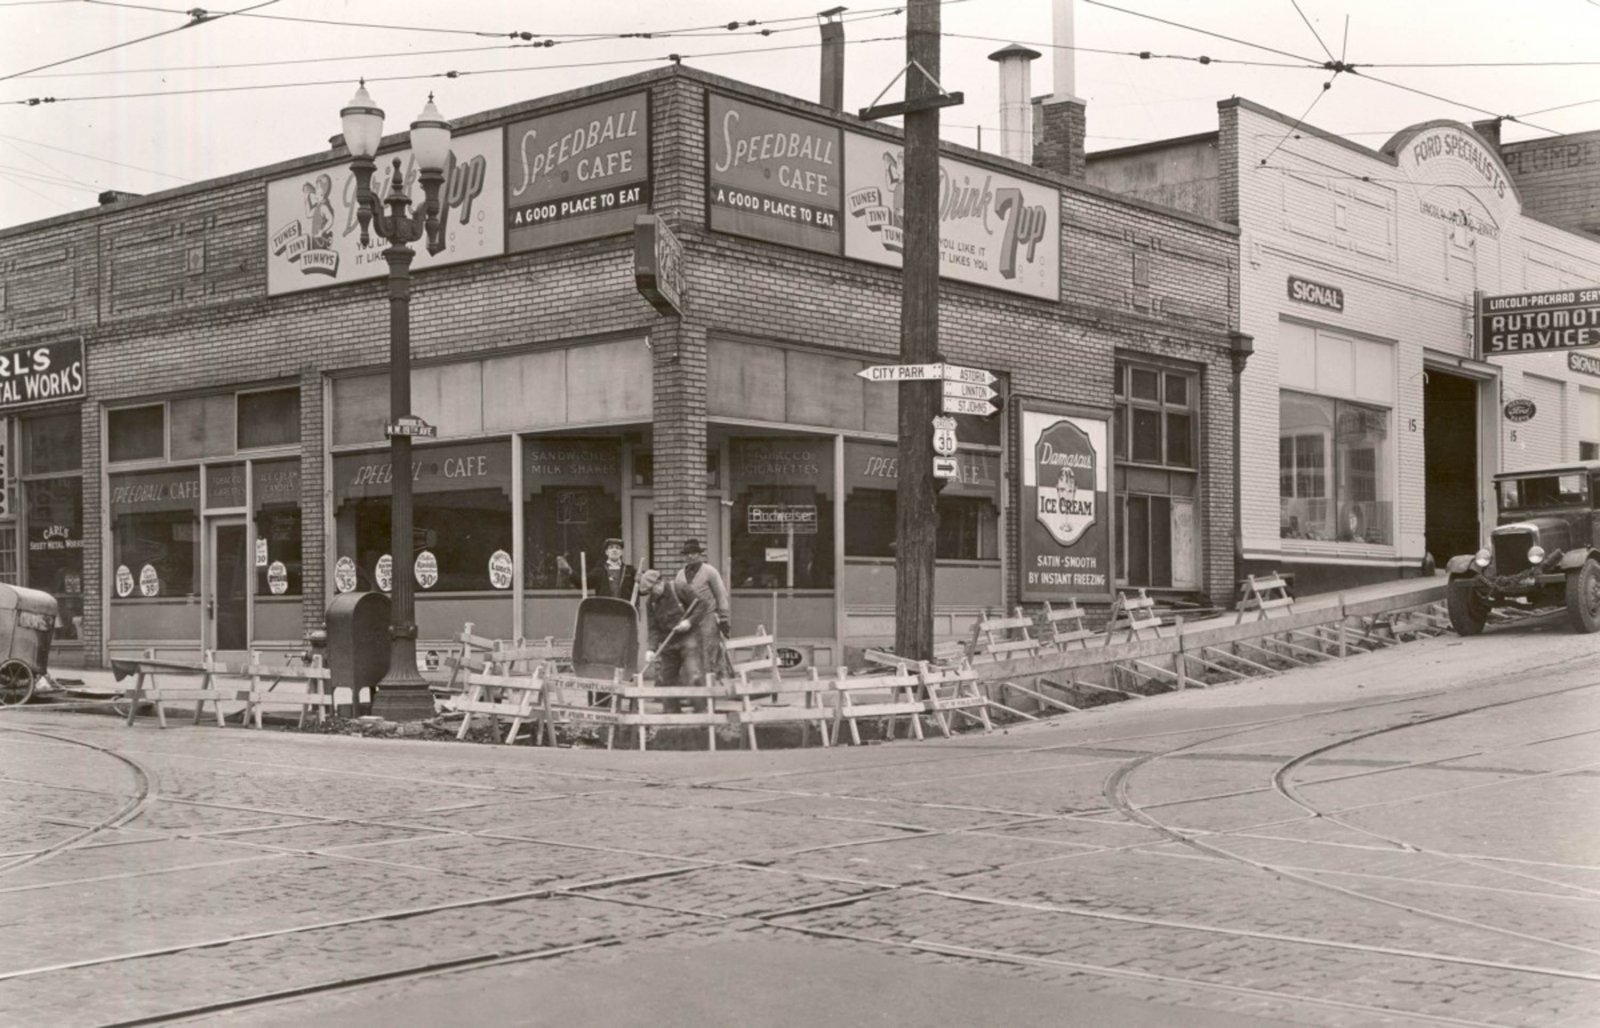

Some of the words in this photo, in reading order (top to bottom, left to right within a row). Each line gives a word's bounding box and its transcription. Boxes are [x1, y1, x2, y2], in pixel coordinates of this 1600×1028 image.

[715, 110, 835, 172] SPEEDBALL
[513, 110, 638, 196] SPEEDBALL
[577, 150, 633, 182] CAFE
[1414, 134, 1442, 166] FORD
[1444, 134, 1505, 199] SPECIALISTS
[779, 165, 828, 196] CAFE
[515, 212, 522, 224] A
[526, 205, 557, 222] GOOD
[561, 197, 597, 216] PLACE
[601, 193, 615, 207] TO
[619, 187, 640, 203] EAT
[717, 190, 725, 202] A
[728, 192, 759, 209] GOOD
[764, 200, 797, 218] PLACE
[801, 208, 812, 222] TO
[816, 211, 834, 227] EAT
[851, 191, 876, 207] TUNES
[868, 210, 886, 222] TINY
[995, 187, 1047, 279] 7up
[356, 238, 374, 250] YU
[958, 240, 976, 254] LIKE
[979, 247, 986, 257] IT
[356, 254, 363, 264] IT
[949, 253, 971, 267] LIKES
[974, 259, 988, 271] YOU
[1292, 280, 1341, 308] SIGNAL
[1490, 292, 1575, 310] LINCOLN-PACKARD
[1580, 290, 1600, 302] SER
[1492, 308, 1600, 333] AUTOMOT
[1492, 328, 1590, 351] SERVICE
[24, 362, 82, 399] WORKS
[872, 367, 895, 379] CITY
[898, 366, 925, 378] PARK
[960, 369, 986, 383] ASTORIA
[961, 385, 987, 398] LINNTON
[1408, 419, 1416, 432] 15
[938, 437, 952, 451] 30
[1510, 429, 1517, 443] 15
[444, 456, 488, 479] CAFE
[531, 464, 561, 474] MILK
[948, 463, 980, 485] AFE
[111, 484, 164, 504] SPEEDBALL
[169, 480, 201, 500] CAFE
[752, 508, 814, 522] Budweiser
[1040, 496, 1057, 514] ICE
[1059, 497, 1092, 516] CREAM
[1028, 571, 1039, 584] BY
[1041, 572, 1072, 585] INSTANT
[1074, 573, 1106, 586] FREEZING
